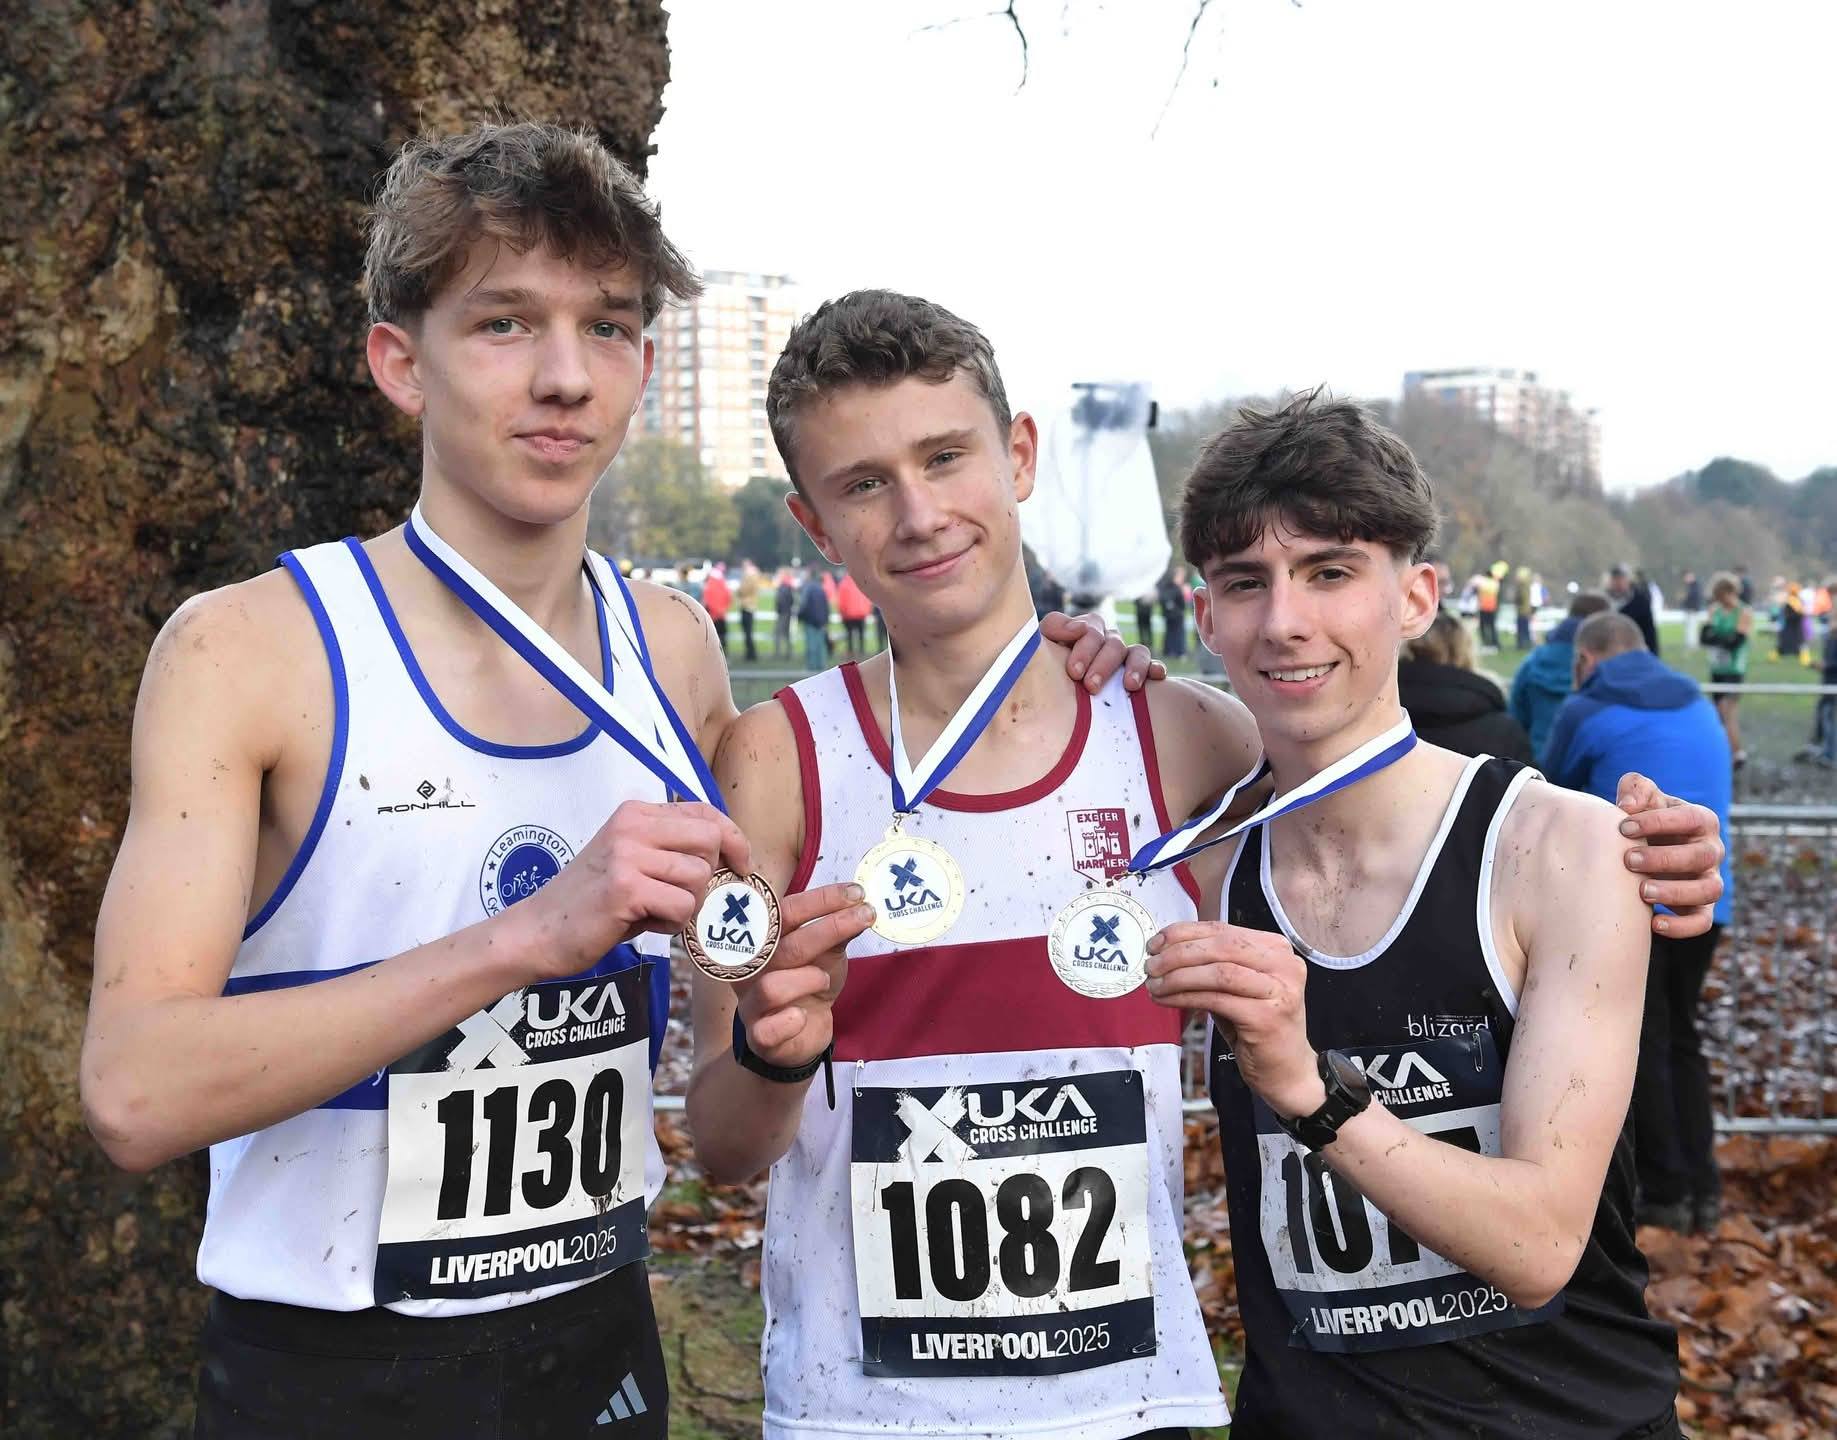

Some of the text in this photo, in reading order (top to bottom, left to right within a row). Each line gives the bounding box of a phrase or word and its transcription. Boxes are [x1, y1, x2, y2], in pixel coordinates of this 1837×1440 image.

[377, 800, 476, 815] RONHILL
[1076, 812, 1119, 823] EXETER
[491, 827, 567, 859] Leamington
[1076, 858, 1130, 870] HARRIERS
[884, 889, 941, 911] UKA
[888, 901, 944, 920] CROSS CHALLENGE
[707, 924, 755, 947] UKA
[705, 940, 756, 955] CROSS CHALLENGE
[1074, 944, 1129, 965] UKA
[1072, 960, 1129, 972] CROSS CHALLENGE
[527, 981, 626, 1030] UKA
[525, 1015, 626, 1049] CROSS CHALLENGE
[1407, 1013, 1489, 1038] blizard
[967, 1083, 1097, 1127] UKA
[1373, 1082, 1454, 1105] CHALLENGE
[969, 1117, 1098, 1145] CROSS CHALLENGE
[437, 1068, 624, 1221] 1130
[881, 1166, 1120, 1301] 1082
